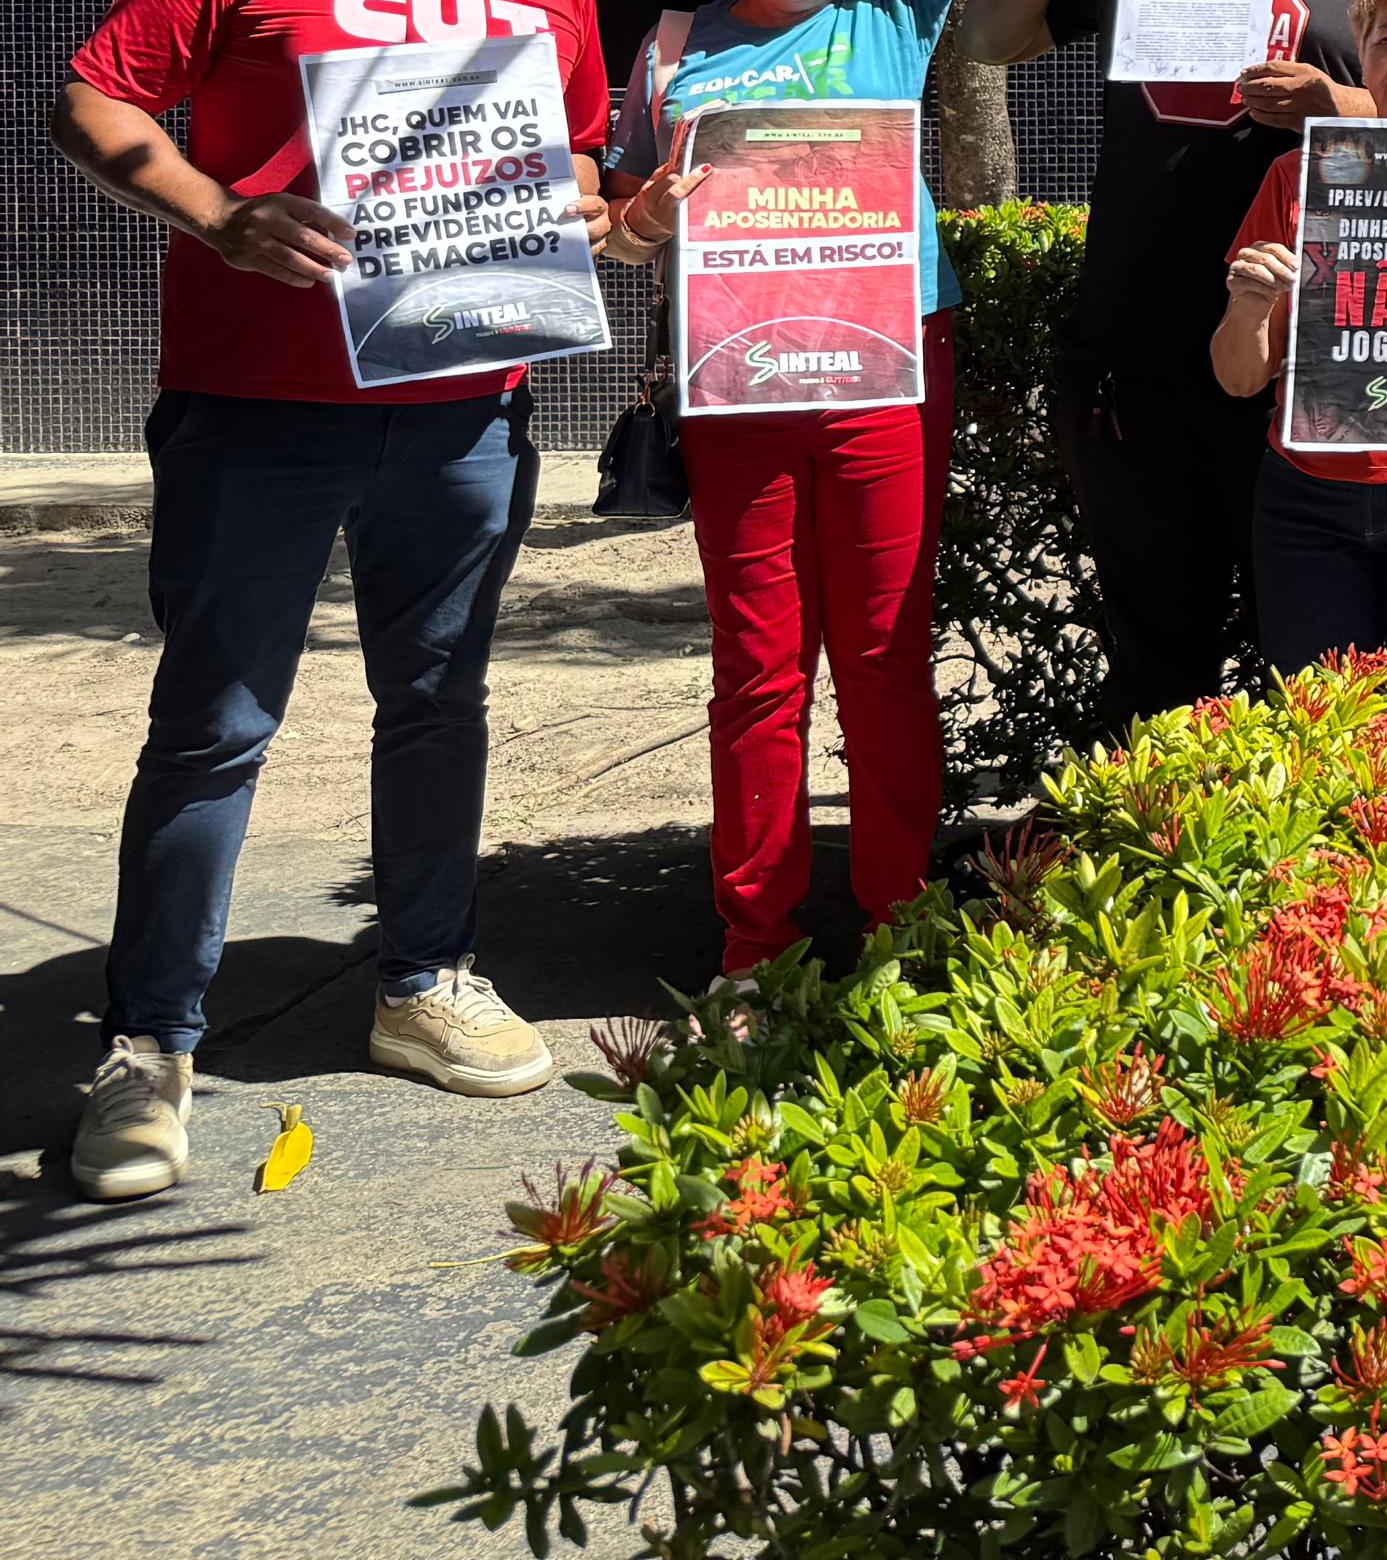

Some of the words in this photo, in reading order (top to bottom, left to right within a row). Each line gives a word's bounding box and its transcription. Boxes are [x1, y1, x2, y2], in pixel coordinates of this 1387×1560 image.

[337, 114, 399, 138] JHC,
[405, 103, 487, 129] QUEM
[492, 98, 539, 120] VAI
[340, 130, 483, 167] COBRIR
[491, 122, 543, 152] OS
[345, 152, 547, 201] PREJUÍZOS
[748, 186, 858, 210] MINHA
[352, 201, 396, 226] AO
[405, 186, 507, 219] FUNDO
[515, 181, 553, 205] DE
[704, 210, 901, 230] APOSENTADORIA
[354, 205, 558, 253] PREVIDÊNCIA
[356, 255, 403, 280] DE
[413, 229, 561, 274] MACEIÓ?
[702, 244, 769, 269] ESTÁ
[775, 246, 813, 266] EM
[819, 241, 903, 265] RISCO!
[423, 302, 531, 345] SINTEAL
[745, 340, 863, 386] SINTEAL
